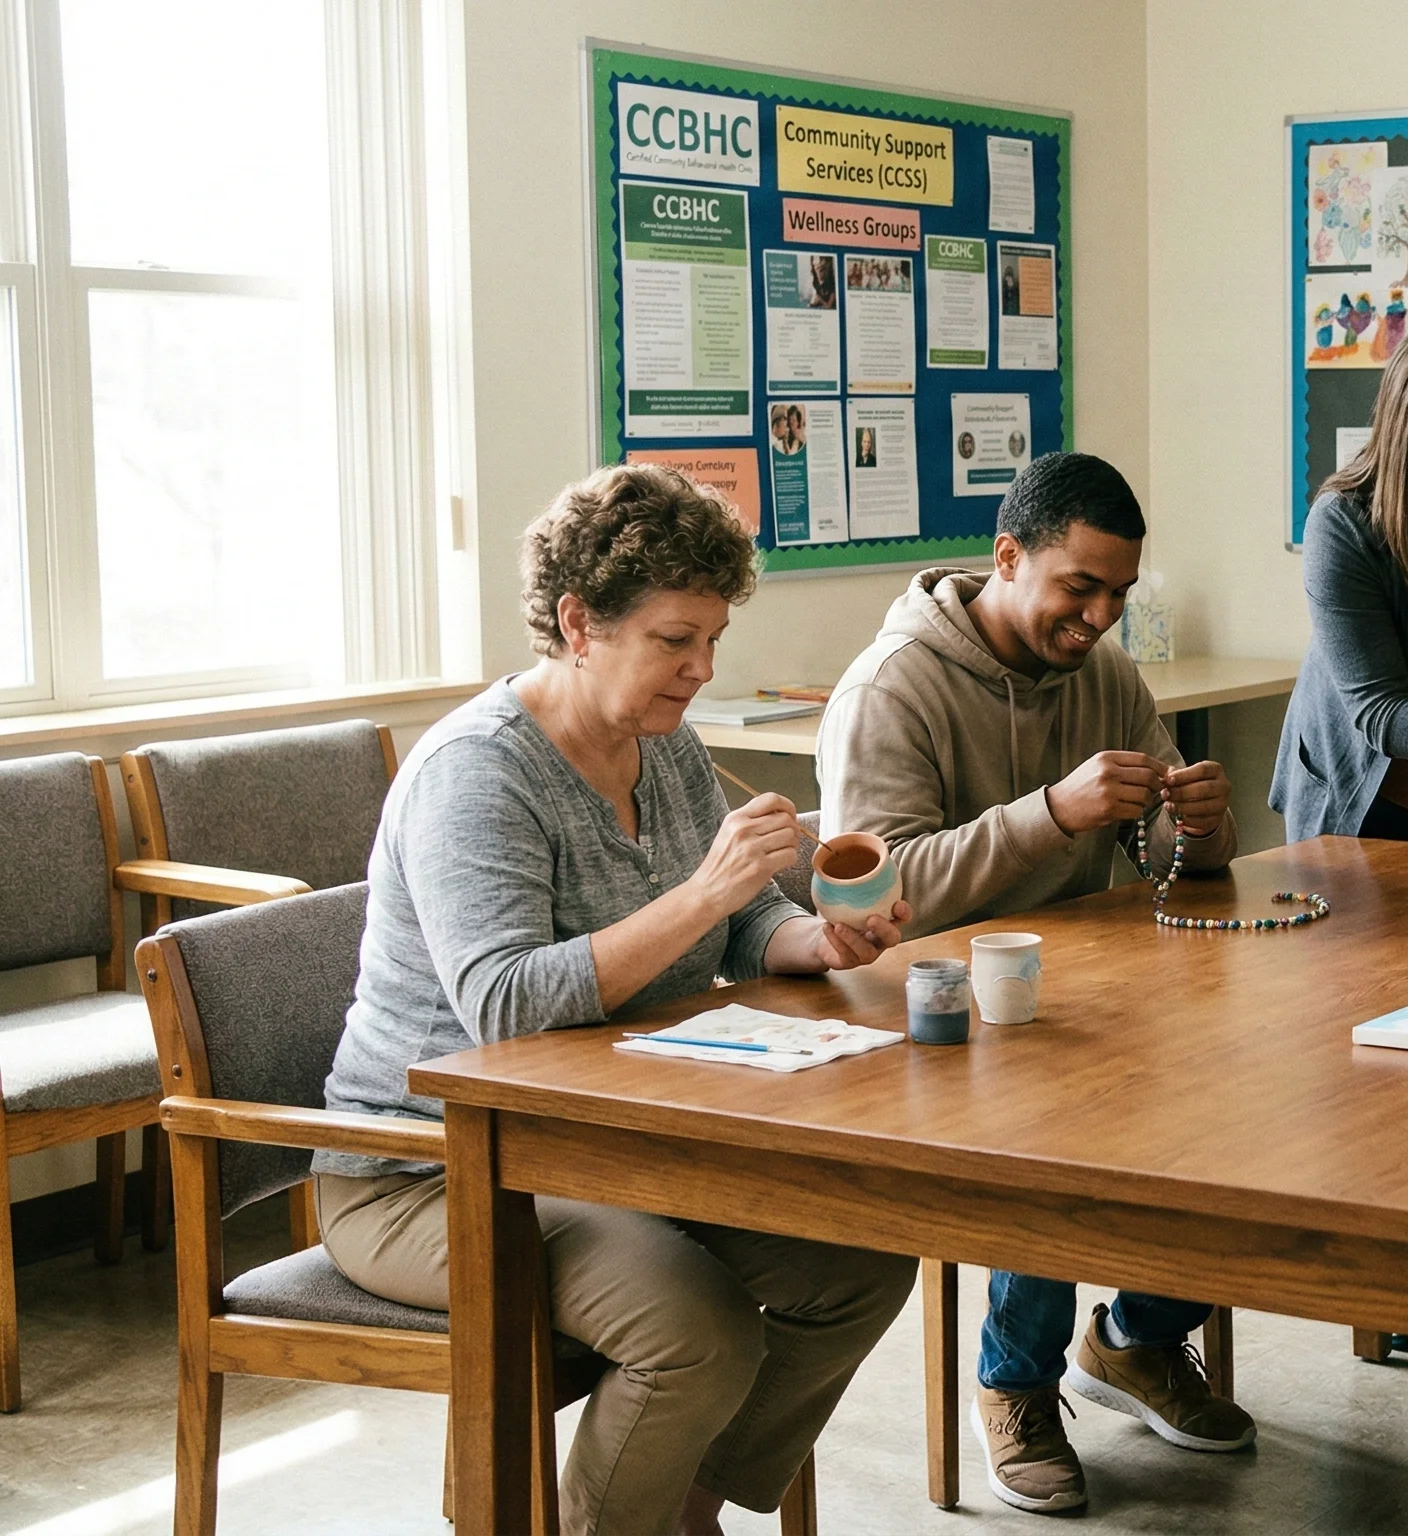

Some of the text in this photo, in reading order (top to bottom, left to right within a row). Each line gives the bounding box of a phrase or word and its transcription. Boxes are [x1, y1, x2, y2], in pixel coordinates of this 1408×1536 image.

[626, 103, 752, 158] CCBHC
[784, 121, 947, 161] Community Support
[806, 157, 928, 194] Services (CCSS)
[653, 194, 720, 222] CCBHC
[788, 210, 917, 243] Wellness Groups
[939, 241, 975, 259] CCBHC
